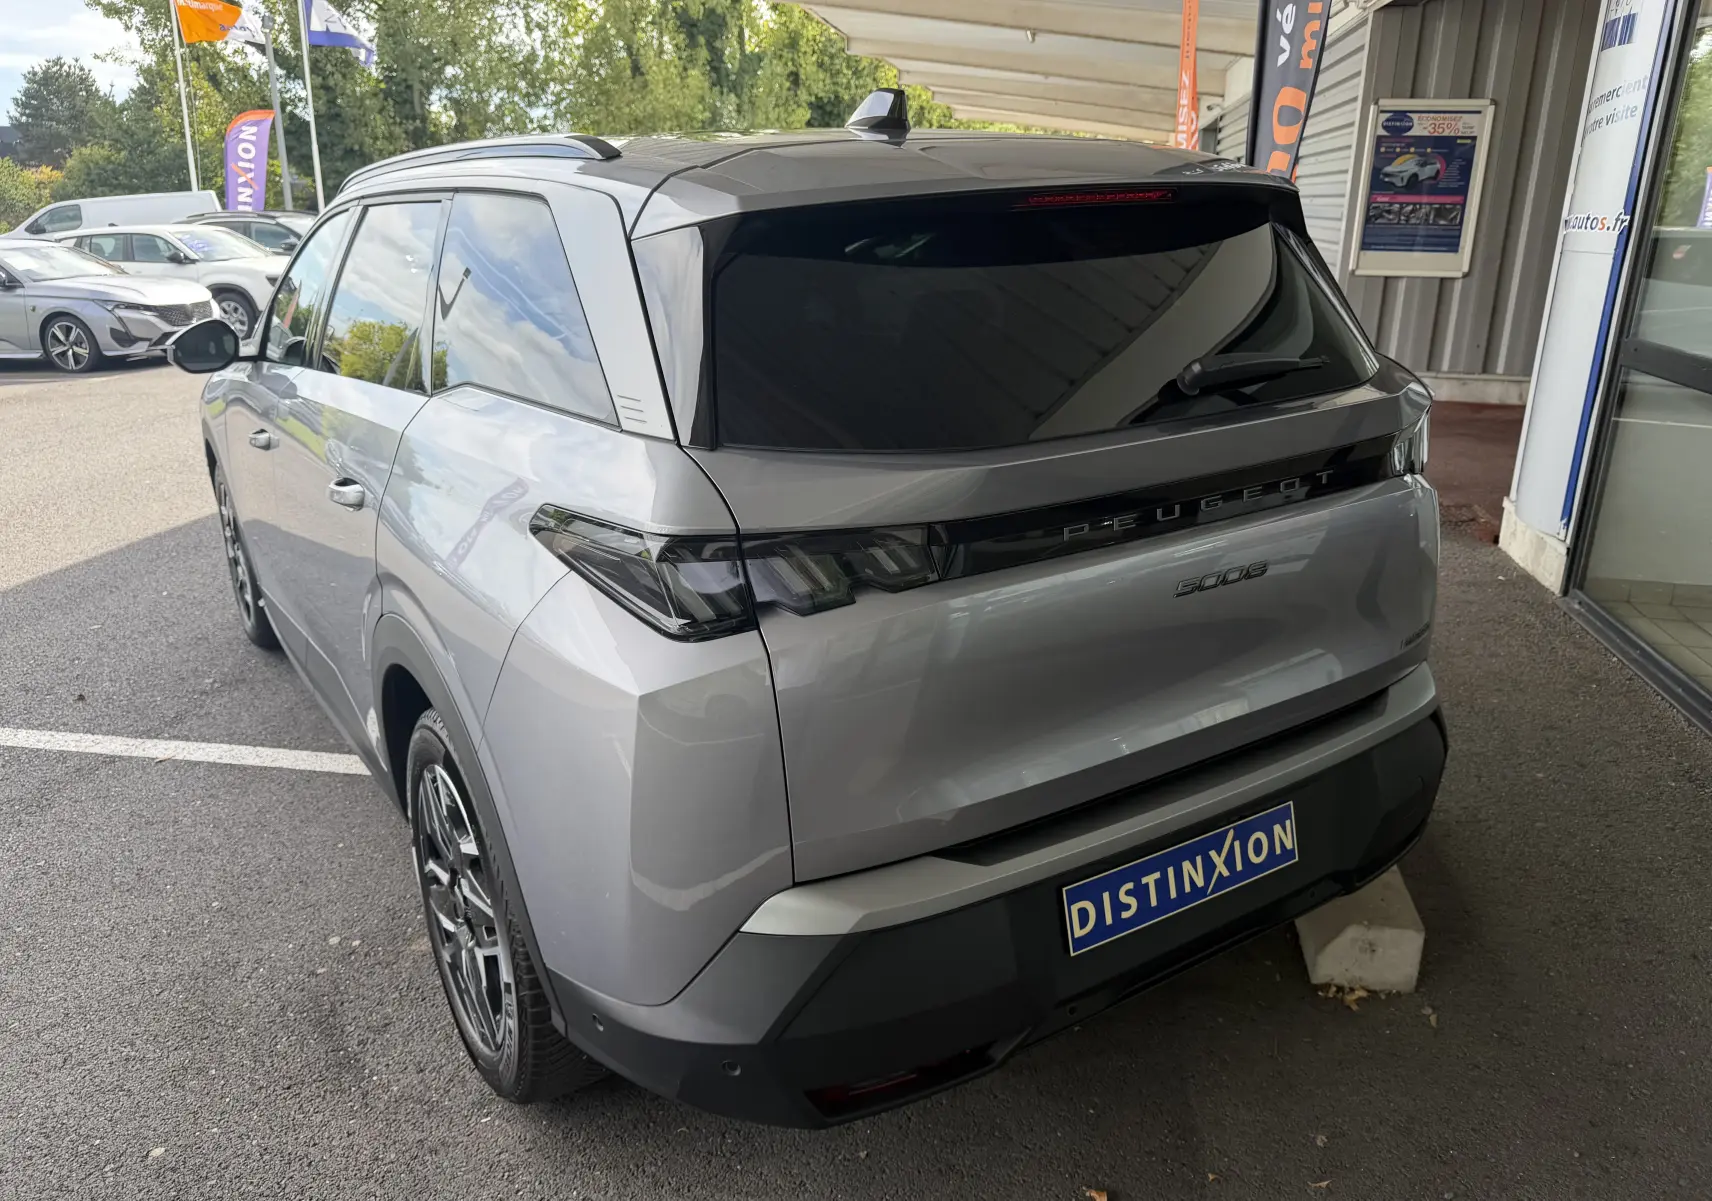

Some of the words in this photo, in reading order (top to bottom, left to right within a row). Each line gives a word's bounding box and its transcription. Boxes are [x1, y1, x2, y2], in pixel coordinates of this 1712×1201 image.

[1605, 105, 1638, 126] visite
[1063, 470, 1334, 541] PEUGEOT
[1173, 560, 1269, 598] 5008
[1070, 819, 1294, 938] DISTINXION
